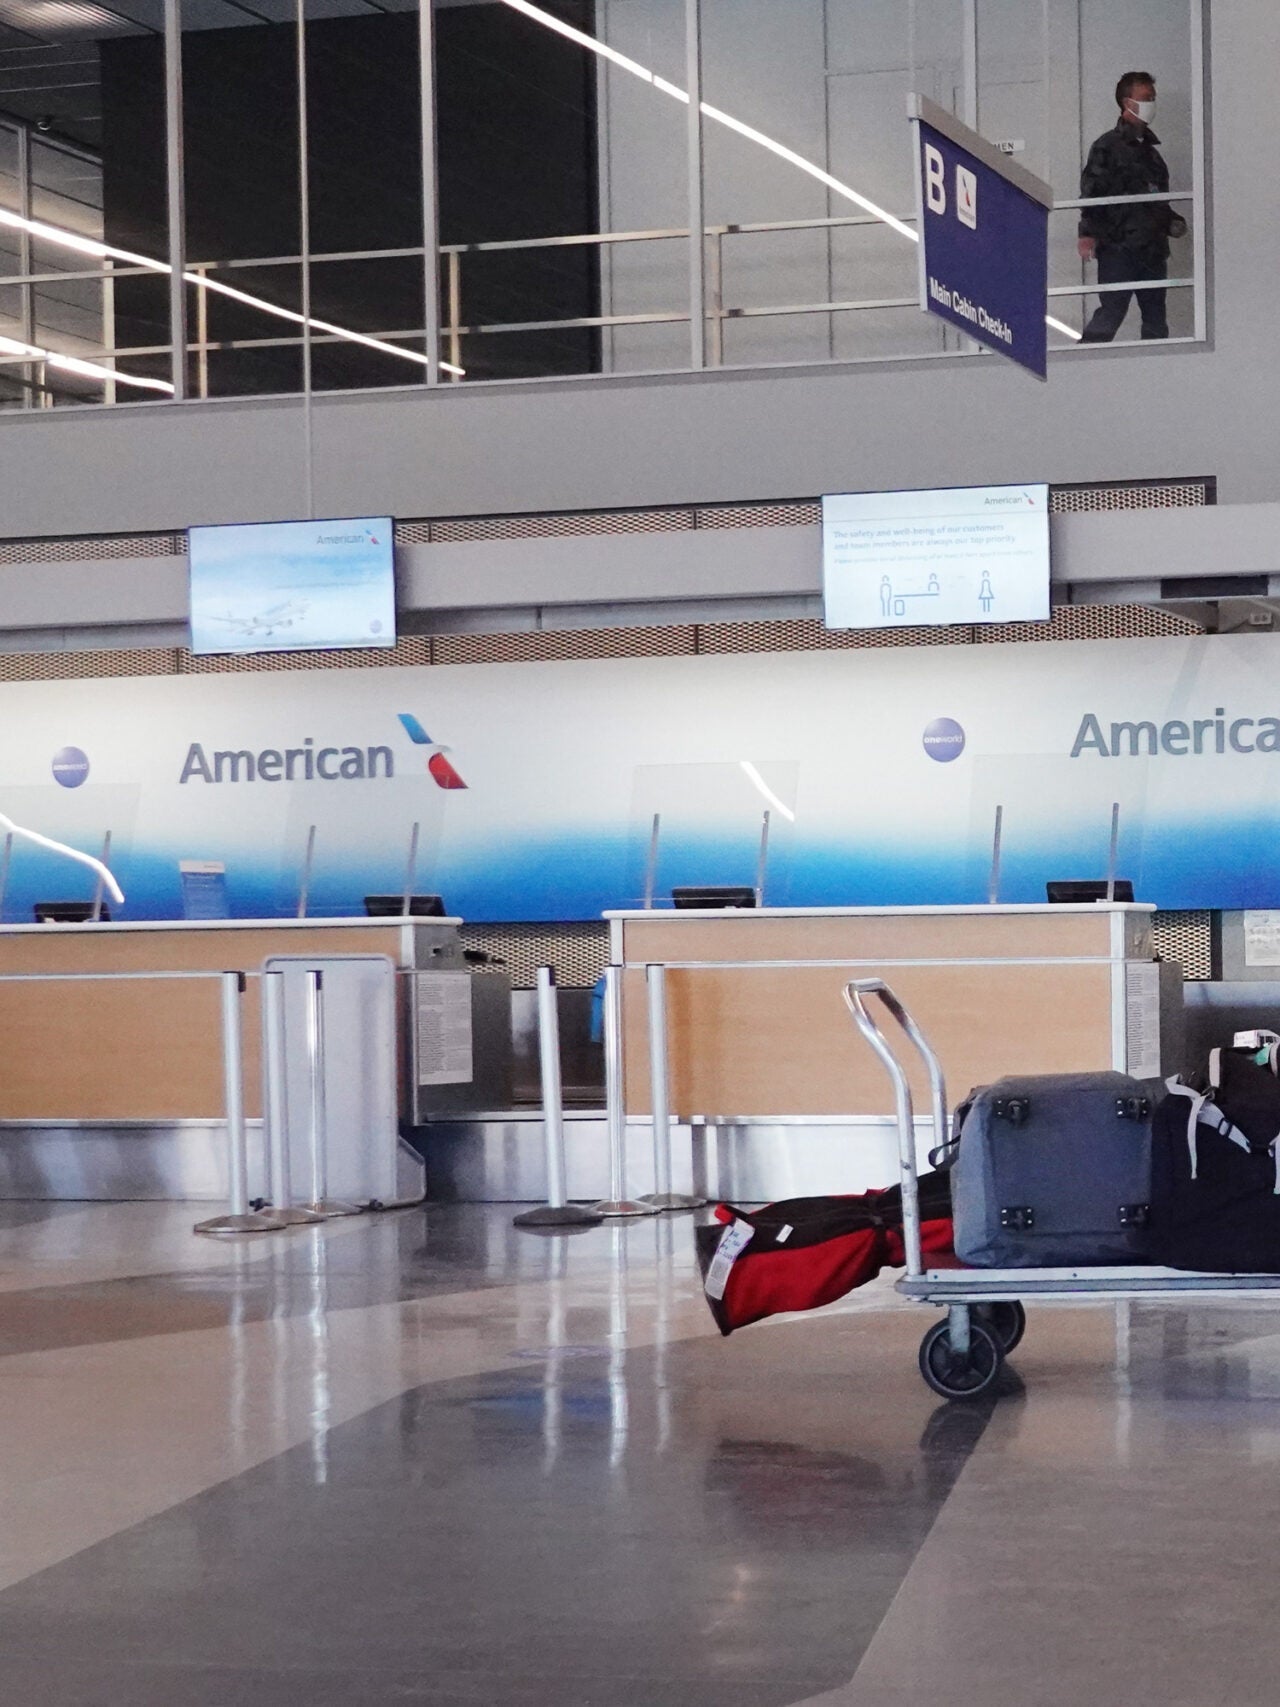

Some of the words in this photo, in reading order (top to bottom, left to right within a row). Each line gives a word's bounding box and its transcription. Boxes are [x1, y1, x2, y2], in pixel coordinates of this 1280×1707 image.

[925, 142, 946, 215] B
[929, 276, 952, 308] Main
[952, 290, 978, 324] Cabin
[978, 306, 1013, 345] Check-In
[984, 495, 1023, 506] American
[316, 534, 364, 544] American
[179, 737, 394, 784] American
